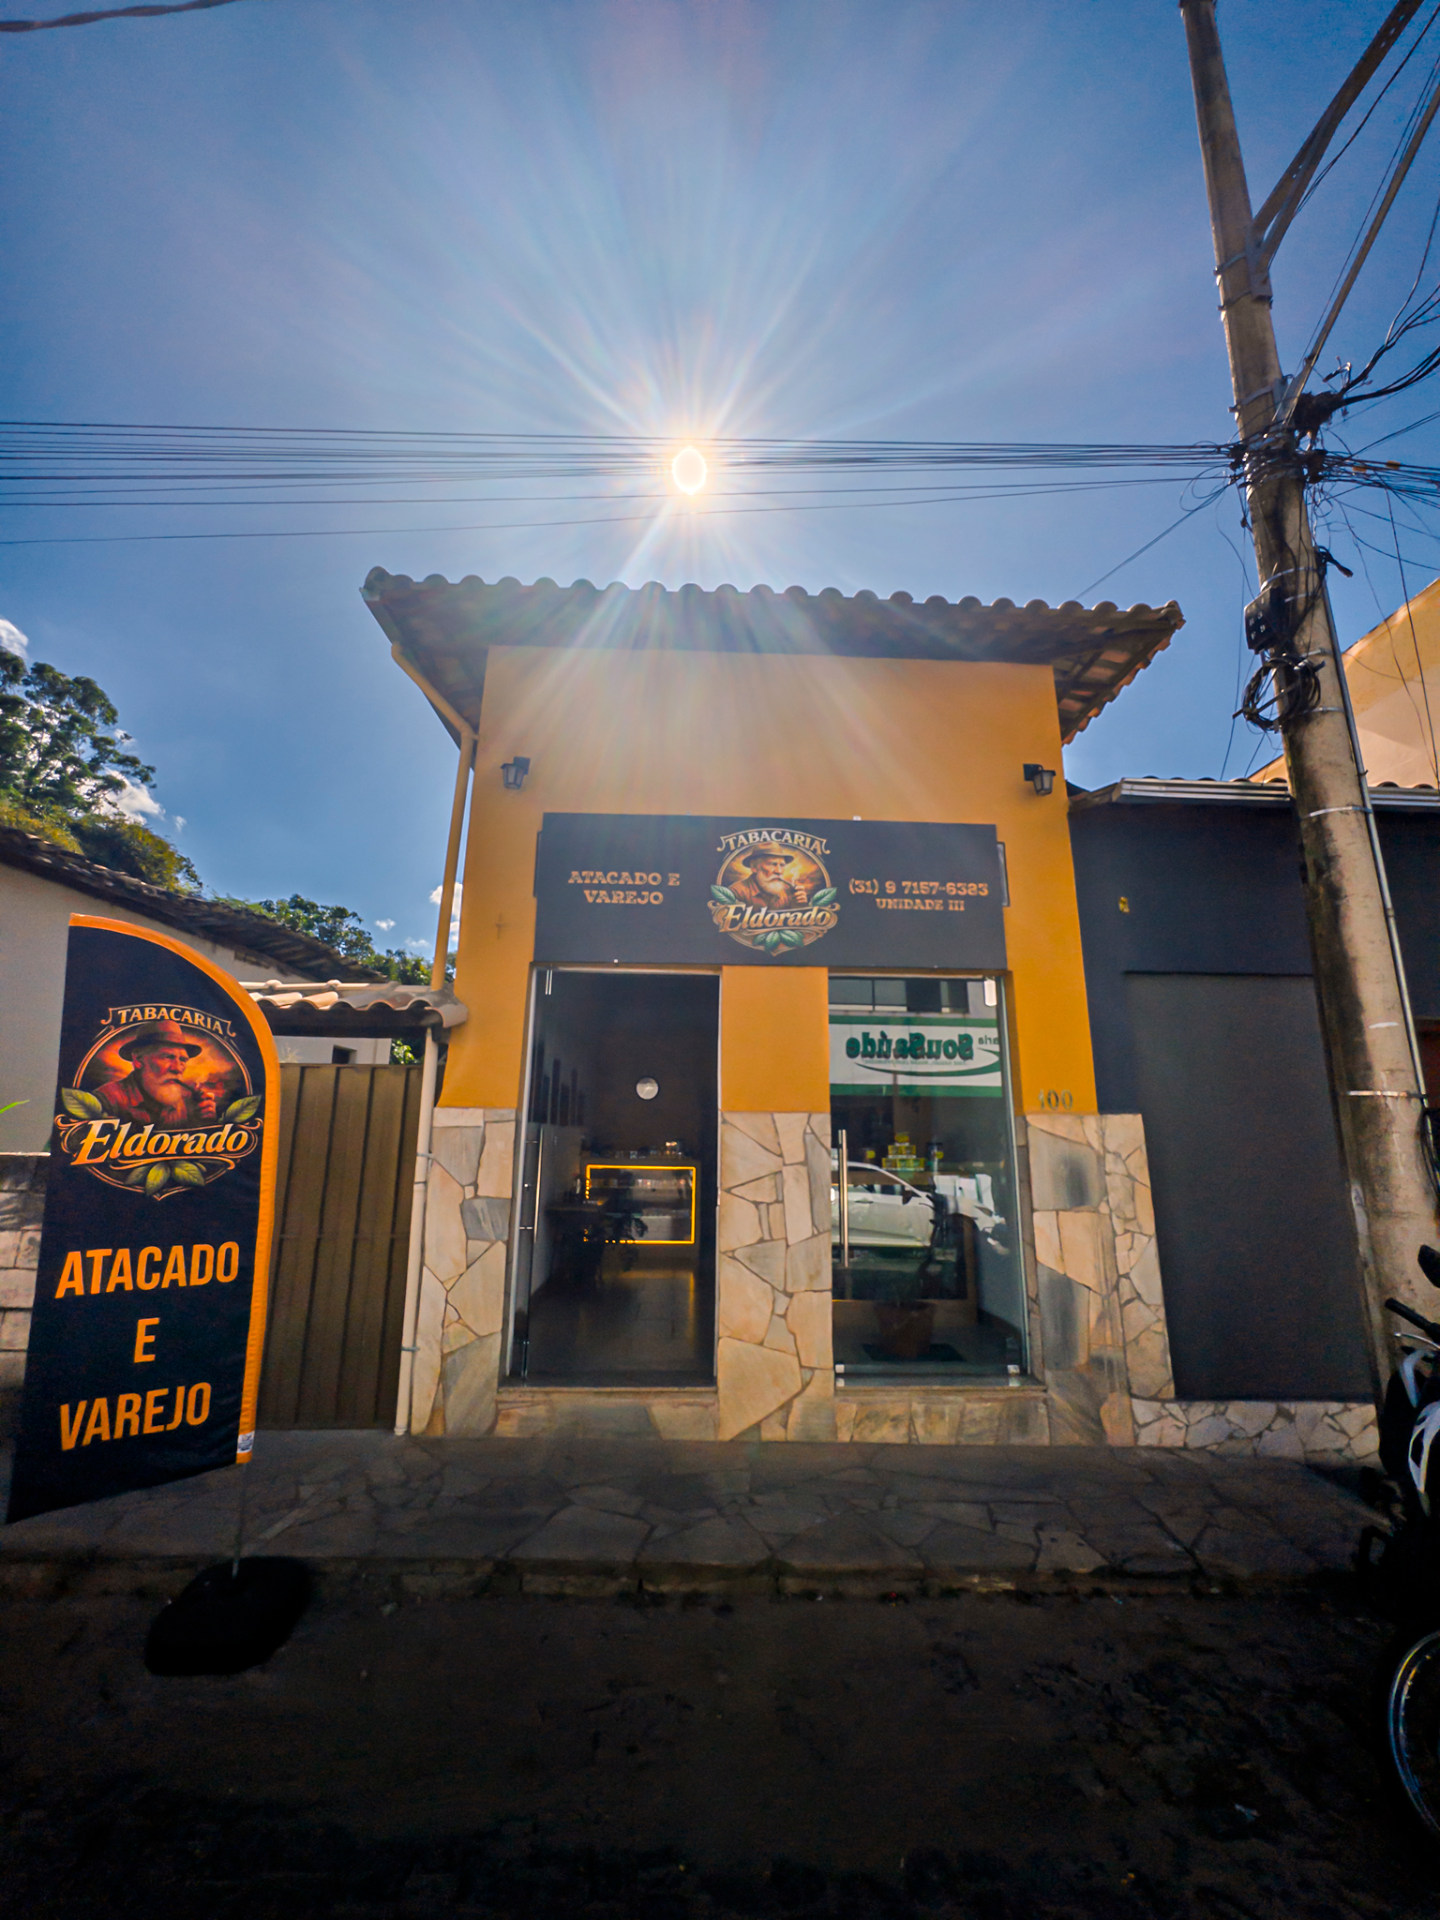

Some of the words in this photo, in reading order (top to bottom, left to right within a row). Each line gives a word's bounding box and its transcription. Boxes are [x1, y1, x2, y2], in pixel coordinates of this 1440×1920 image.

[725, 830, 822, 854] TABACARIA
[568, 870, 662, 885] ATACADO
[667, 873, 680, 886] E
[849, 878, 879, 895] (31)
[885, 880, 896, 894] 9
[583, 890, 664, 905] VAREJO
[875, 898, 944, 911] UNIDADE
[719, 904, 831, 932] Eldorado
[118, 1007, 223, 1034] TABACARIA
[1038, 1089, 1073, 1110] 100
[71, 1119, 248, 1165] Eldorado
[55, 1241, 240, 1299] ATACADO
[134, 1317, 160, 1363] E
[60, 1382, 212, 1450] VAREJO
